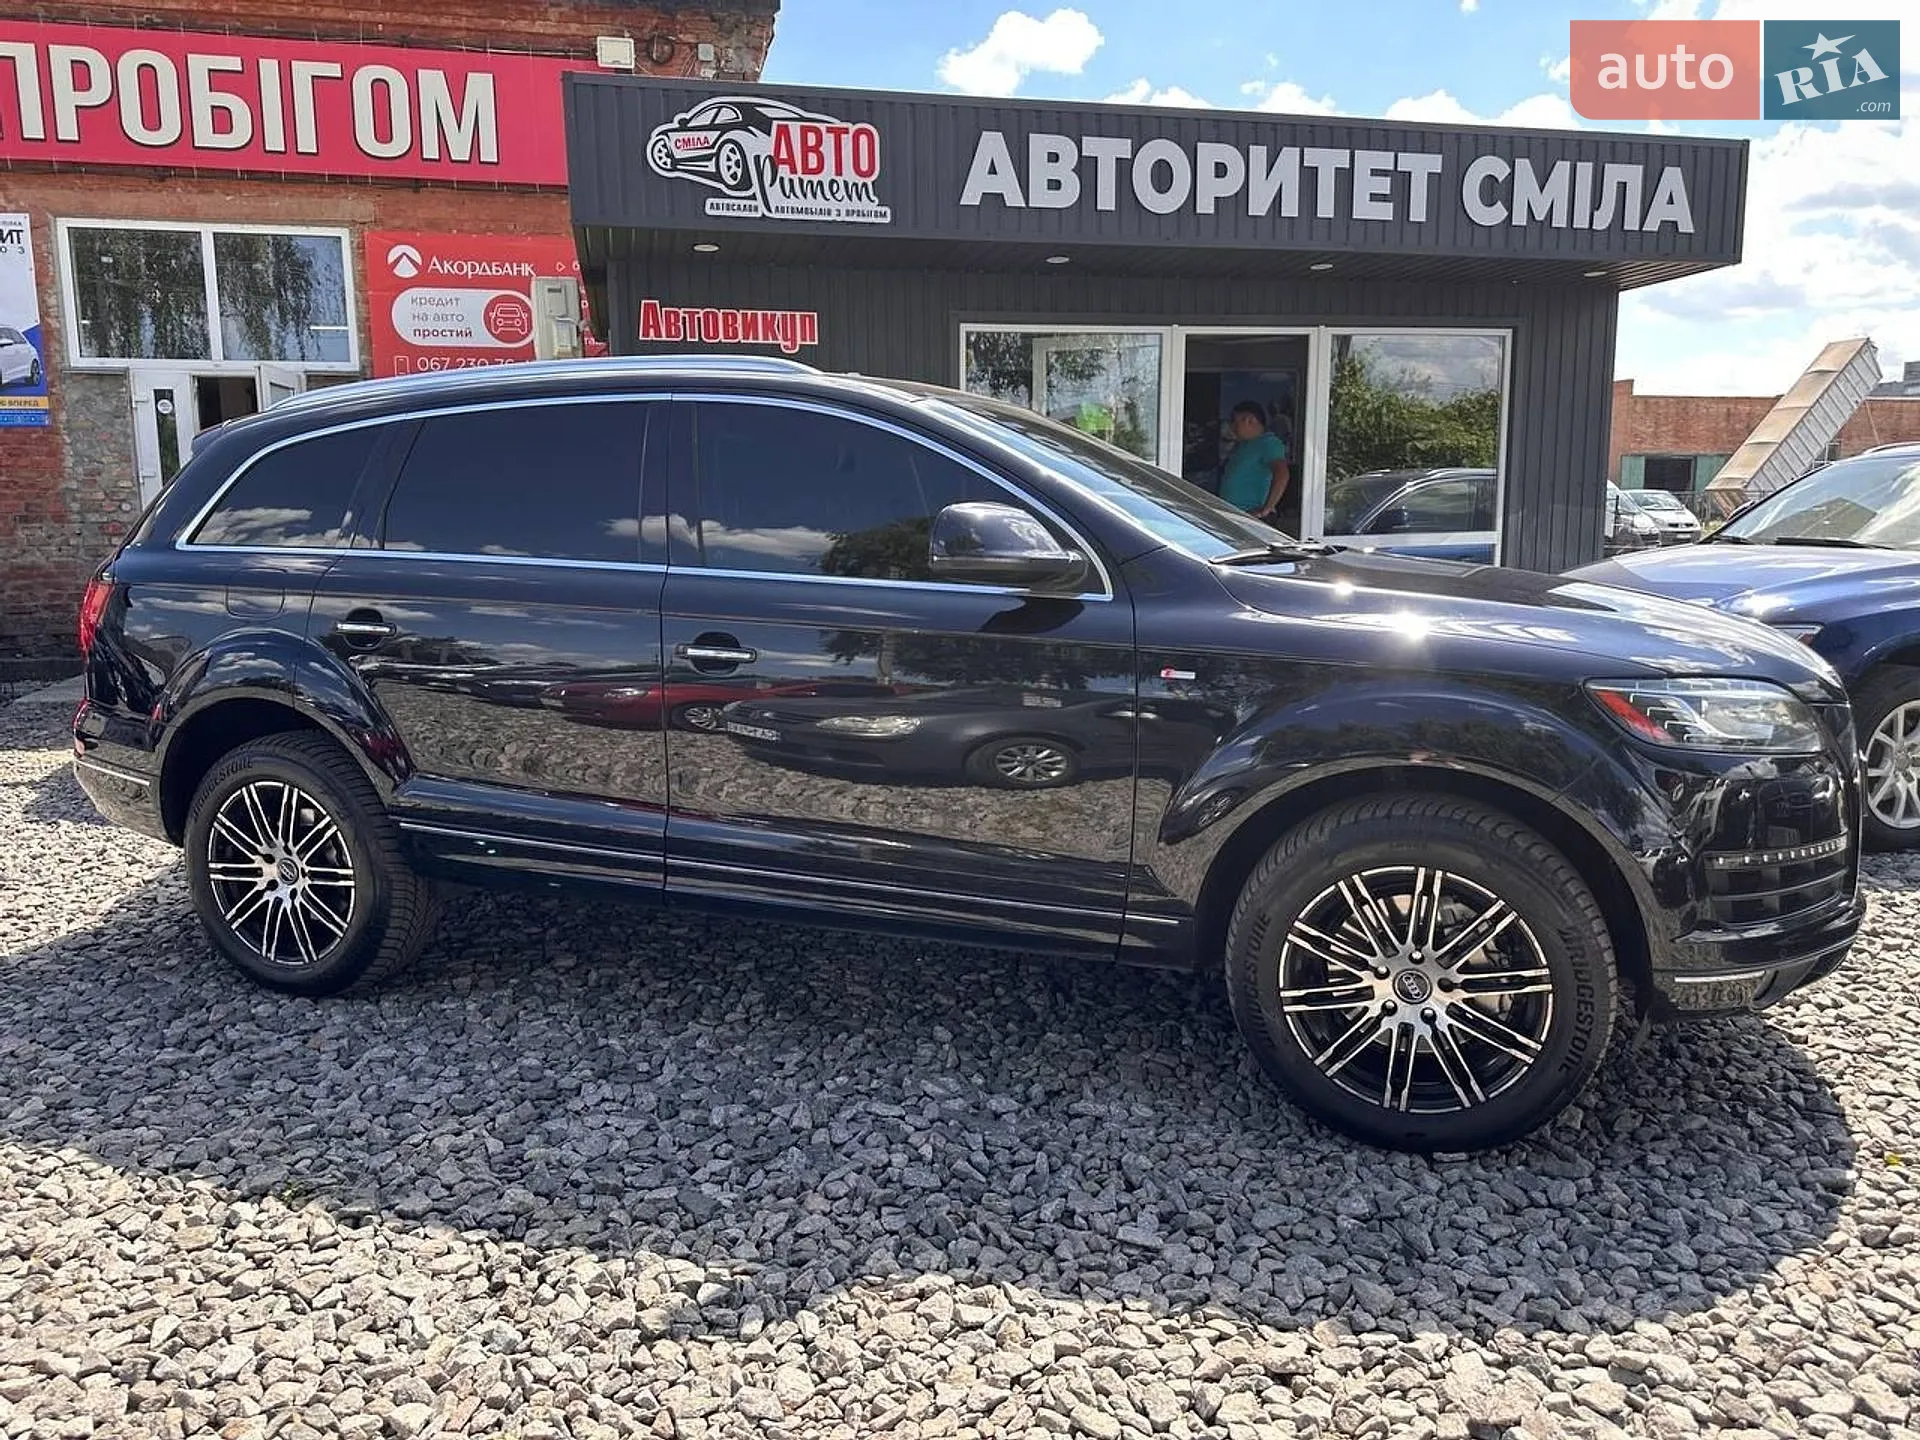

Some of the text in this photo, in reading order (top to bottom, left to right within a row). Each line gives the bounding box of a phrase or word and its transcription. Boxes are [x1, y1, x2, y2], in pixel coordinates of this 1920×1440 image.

[0, 42, 499, 164] ПРОБІГОМ
[674, 136, 711, 150] СМІЛА
[772, 123, 878, 178] АВТО
[960, 131, 1695, 234] АВТОРИТЕТ СМІЛА
[709, 202, 759, 213] АВТОСАЛОН
[411, 295, 460, 307] кредит
[412, 313, 464, 323] на авто
[413, 327, 473, 340] простий
[417, 357, 450, 371] 067
